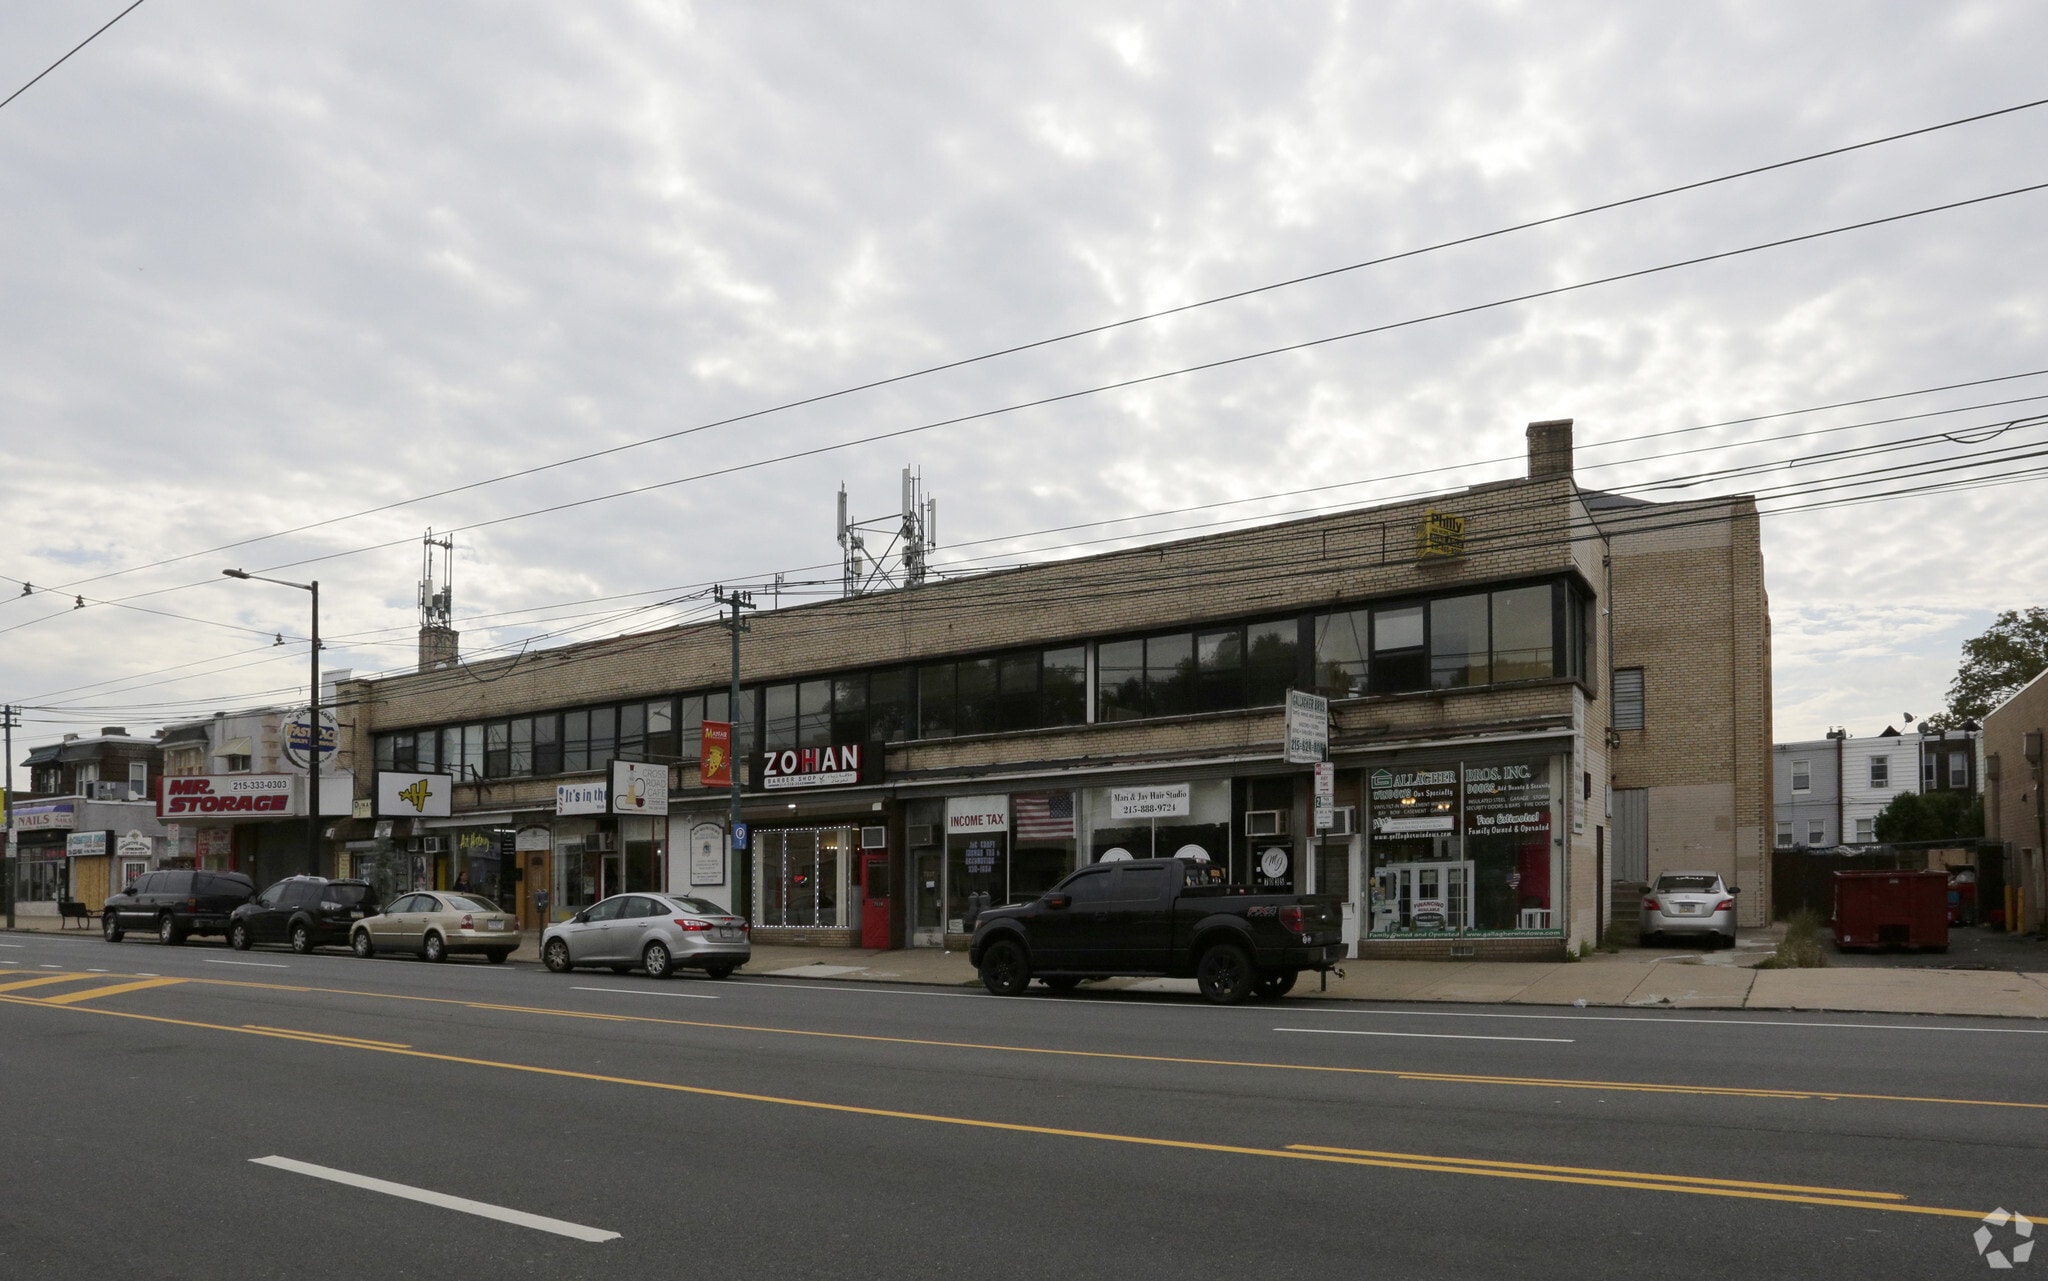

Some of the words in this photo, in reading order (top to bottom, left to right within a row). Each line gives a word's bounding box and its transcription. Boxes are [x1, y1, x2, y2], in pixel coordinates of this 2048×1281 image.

[1432, 513, 1462, 532] Philly
[764, 745, 858, 776] ZOHAN
[643, 769, 666, 778] CROSS
[1465, 767, 1501, 782] BROS.
[1504, 765, 1531, 780] INC.
[169, 779, 215, 795] MR.
[233, 781, 287, 790] 215-333-0303
[646, 779, 666, 788] ROAD
[1466, 783, 1495, 794] DOORS
[566, 790, 580, 802] It's
[583, 788, 592, 802] in
[648, 788, 666, 797] CAFE
[1138, 792, 1148, 802] Jay
[1150, 792, 1164, 800] Hair
[1166, 790, 1187, 798] Studio
[1426, 788, 1453, 798] Specialty
[168, 795, 289, 812] STORAGE
[1124, 804, 1176, 814] 215-888-9724
[19, 814, 50, 826] NAILS
[950, 815, 984, 827] INCOME
[986, 814, 1004, 825] TAX
[1468, 827, 1490, 836] Family
[1520, 824, 1550, 832] Operated
